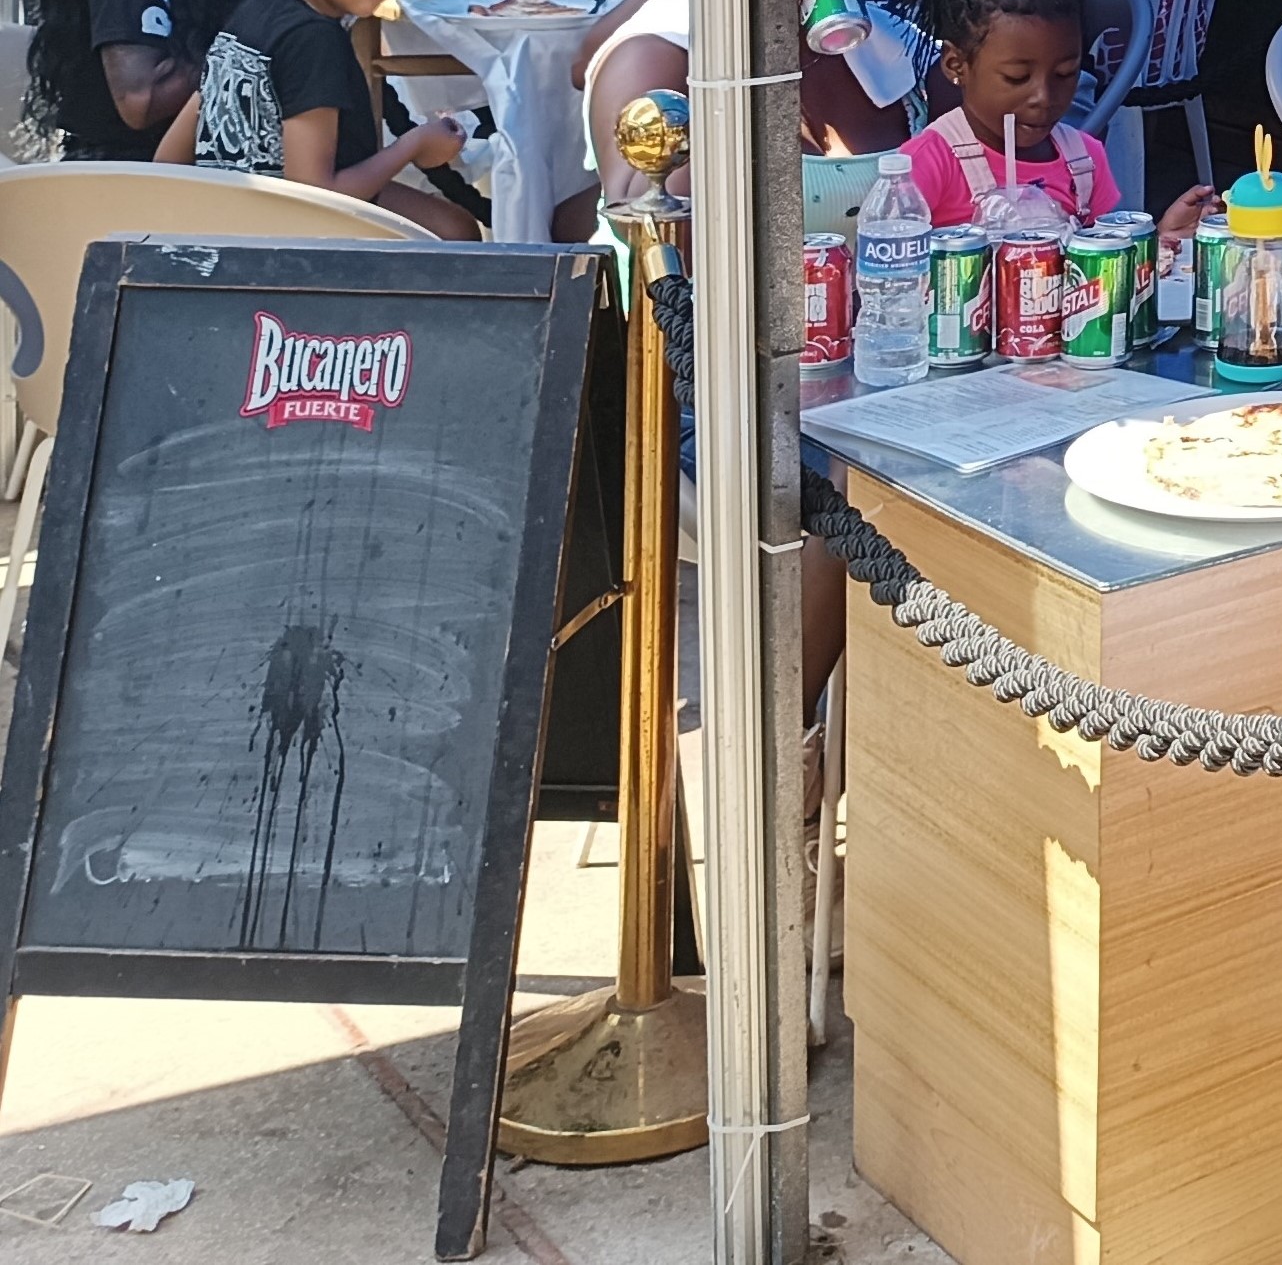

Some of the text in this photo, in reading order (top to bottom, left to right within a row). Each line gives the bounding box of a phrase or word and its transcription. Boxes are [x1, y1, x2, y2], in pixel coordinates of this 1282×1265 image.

[865, 238, 929, 262] AQUELL
[1020, 288, 1062, 316] BOO
[1062, 285, 1100, 316] STAL
[1019, 324, 1045, 334] COLA
[245, 314, 409, 410] Bucanero
[283, 400, 362, 420] FUERTE
